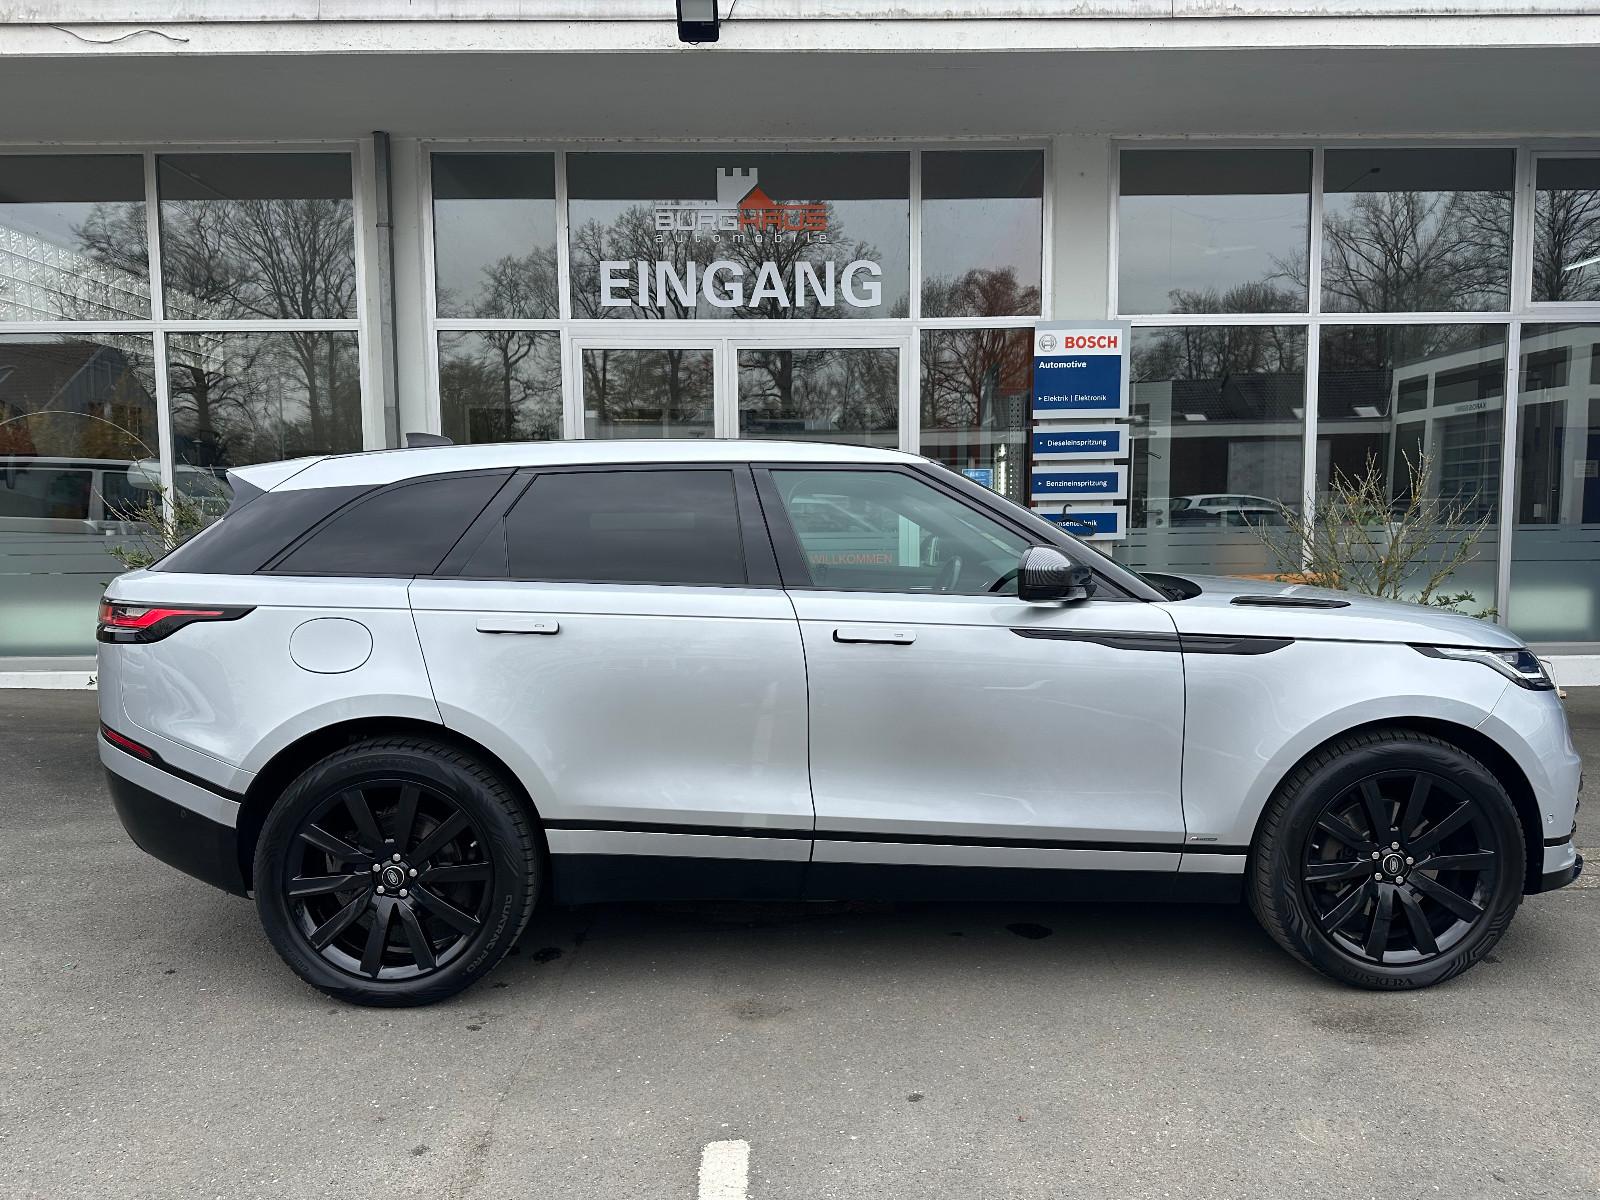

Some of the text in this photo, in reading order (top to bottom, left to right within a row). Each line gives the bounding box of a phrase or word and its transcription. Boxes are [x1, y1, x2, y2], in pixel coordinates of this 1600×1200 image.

[655, 208, 828, 232] BURGHAUS
[655, 232, 828, 244] automobile
[599, 259, 883, 308] EINGANG
[1064, 335, 1118, 349] BOSCH
[1038, 360, 1087, 369] Automotive
[1074, 394, 1107, 402] Elektronik
[1047, 439, 1107, 447] Dieseleinspritzung
[1046, 480, 1108, 488] Benzineinspritzung
[809, 552, 893, 565] WILLKOMMEN
